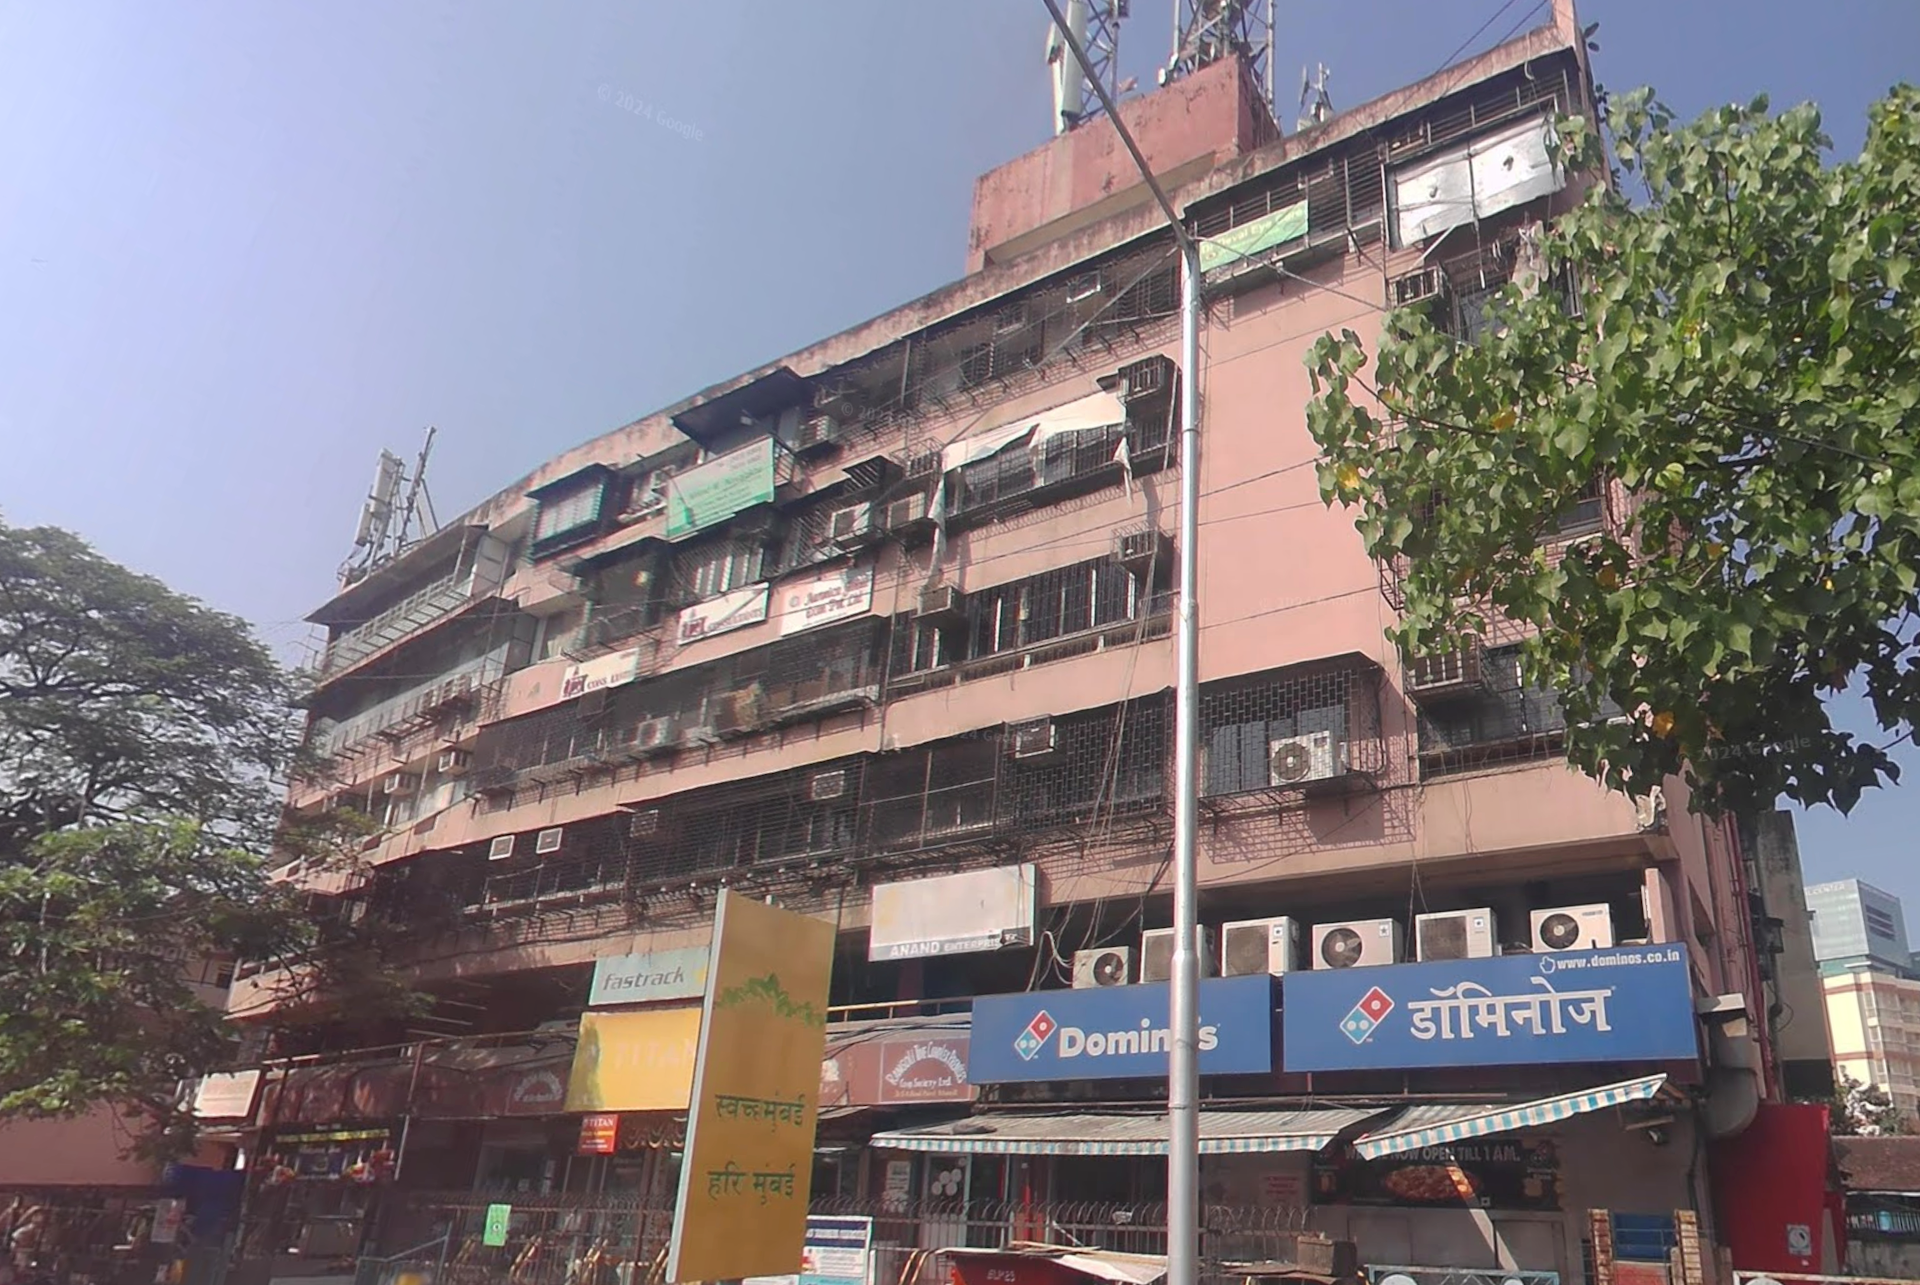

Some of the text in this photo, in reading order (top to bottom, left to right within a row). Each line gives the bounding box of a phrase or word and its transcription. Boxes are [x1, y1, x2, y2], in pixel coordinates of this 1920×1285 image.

[889, 941, 941, 957] ANAND
[1556, 949, 1680, 970] www.dominos.co.in
[603, 966, 685, 991] fastrack
[1408, 976, 1613, 1040] डॉमिनोज
[1059, 1017, 1219, 1057] Domin's
[589, 1118, 614, 1127] TITAN
[1423, 1147, 1455, 1161] OPEN
[1457, 1146, 1482, 1161] TILL
[707, 1161, 796, 1205] हरि मुंबई
